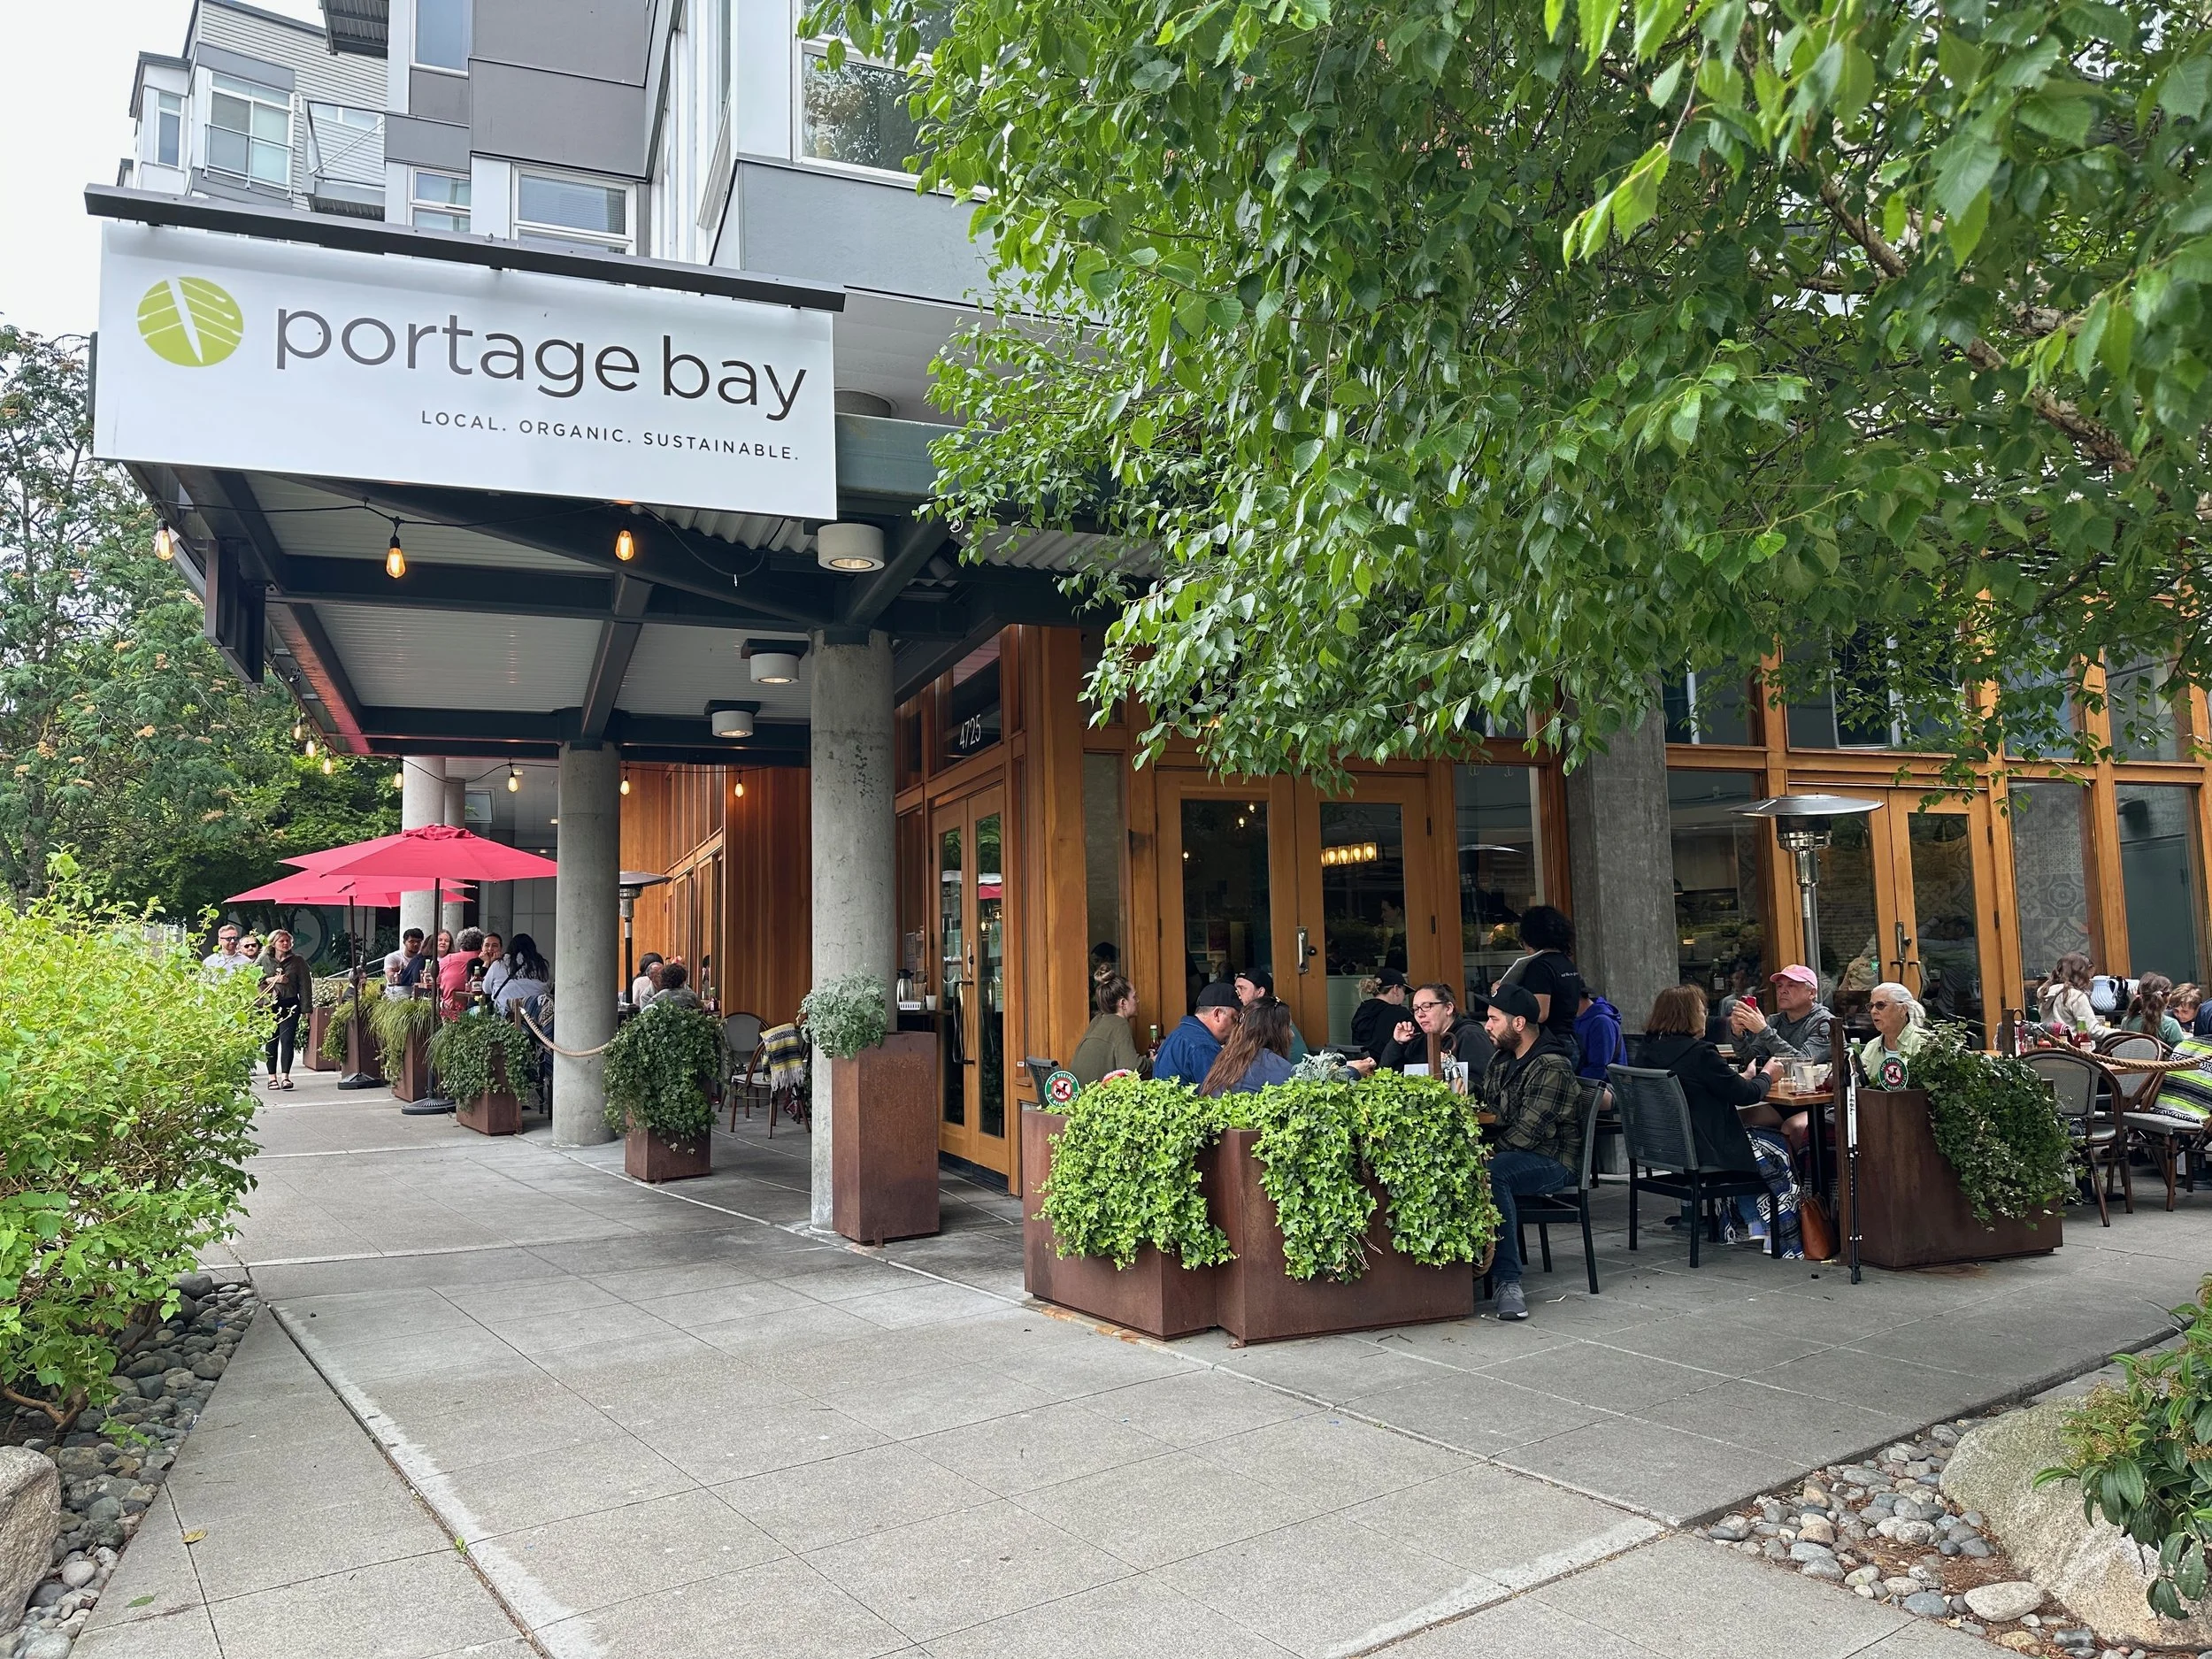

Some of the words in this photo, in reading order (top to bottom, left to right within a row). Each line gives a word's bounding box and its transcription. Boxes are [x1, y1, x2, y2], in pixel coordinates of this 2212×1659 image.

[277, 308, 640, 398] portage
[663, 334, 807, 421] bay
[422, 411, 506, 433] LOCAL.
[519, 419, 631, 443] ORGANIC.
[643, 432, 799, 459] SUSTAINABLE.
[959, 714, 981, 749] 4725
[1048, 1076, 1056, 1085] NO
[1057, 1073, 1075, 1083] PEEING
